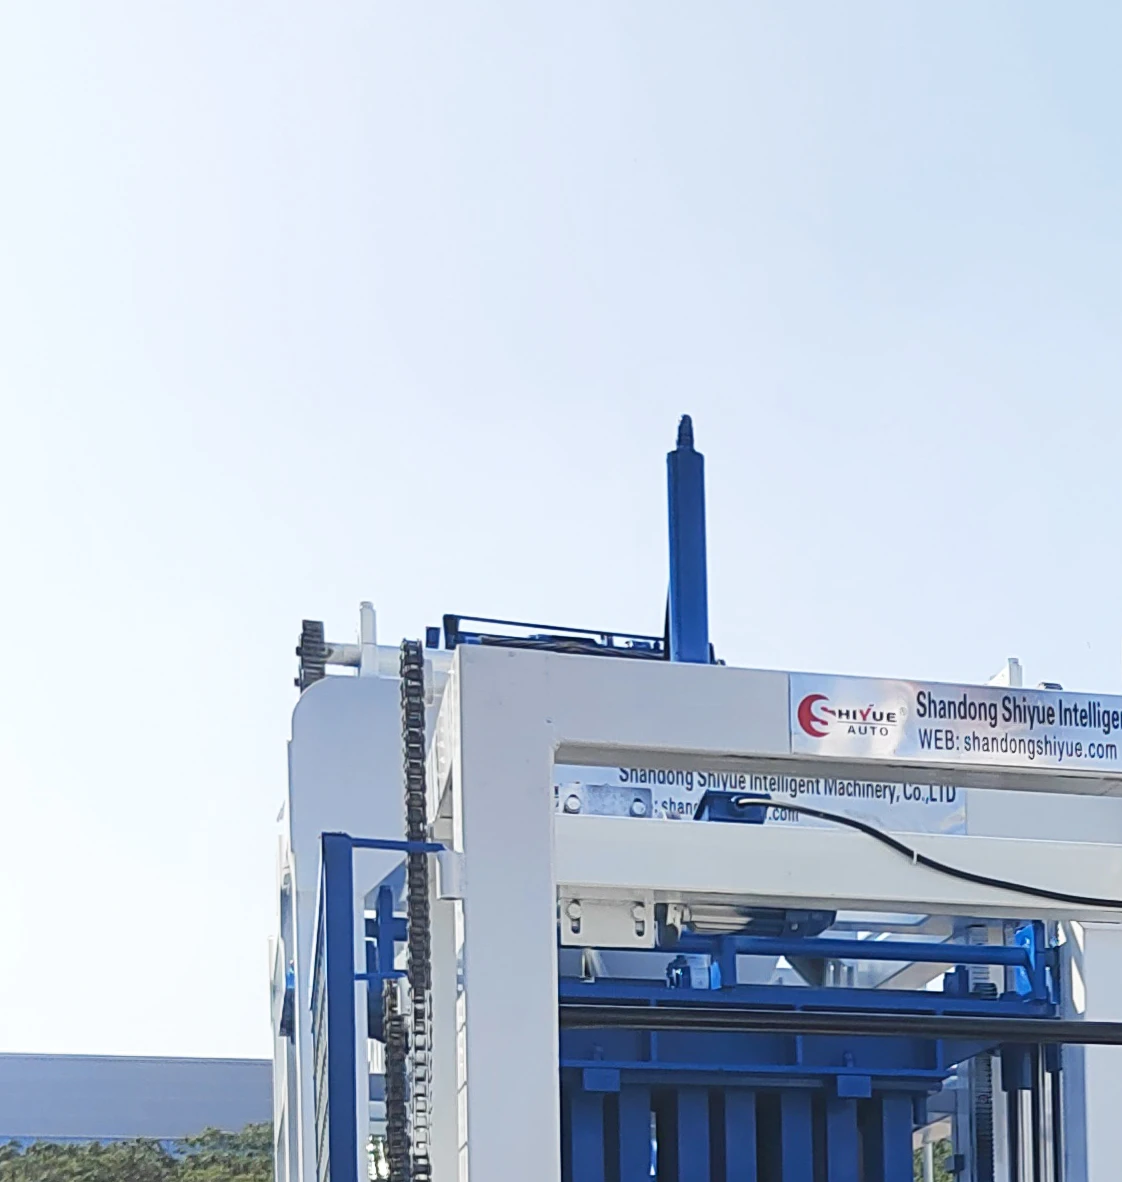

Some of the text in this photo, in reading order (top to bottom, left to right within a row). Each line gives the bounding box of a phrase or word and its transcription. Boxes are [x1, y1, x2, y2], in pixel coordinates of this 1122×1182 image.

[916, 690, 998, 728] Shandong
[1002, 695, 1056, 731] Shiyue
[847, 725, 889, 737] AUTO
[918, 728, 960, 751] WEB:
[963, 730, 1118, 762] shandongshiyue.com
[619, 767, 694, 791] Shandong
[697, 770, 747, 791] Shiyue
[749, 774, 821, 798] Intelligent
